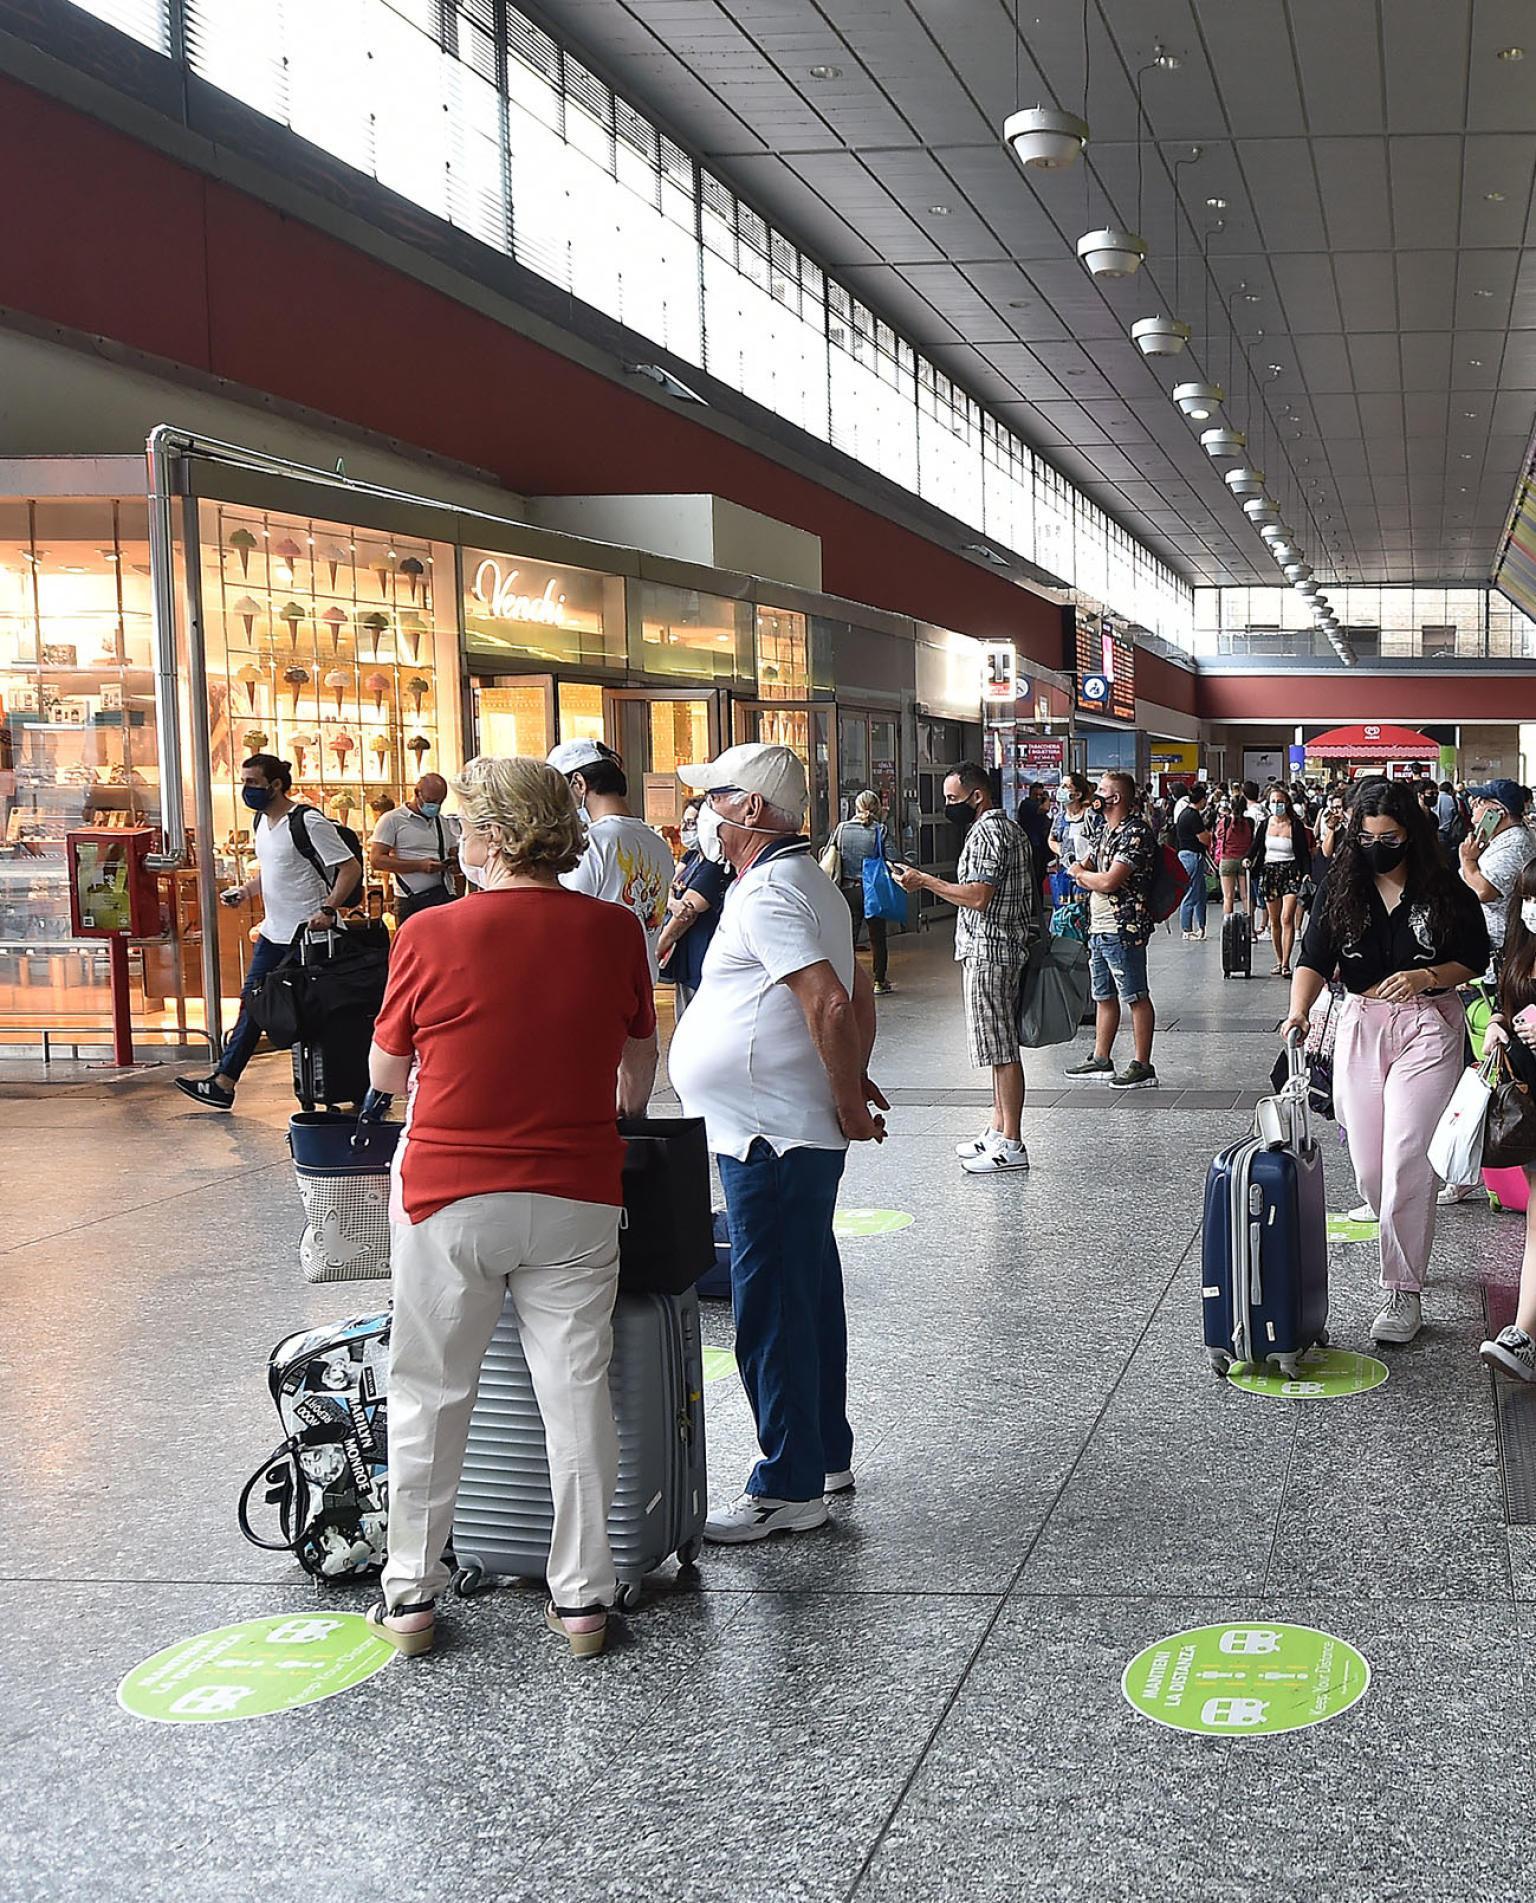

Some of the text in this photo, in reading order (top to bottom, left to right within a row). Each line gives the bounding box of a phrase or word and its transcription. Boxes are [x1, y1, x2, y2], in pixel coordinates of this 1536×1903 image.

[471, 559, 567, 626] Venchi
[197, 1082, 210, 1095] N
[305, 1398, 334, 1425] REPORT
[348, 1396, 374, 1448] MARILYN
[343, 1437, 371, 1493] MONROE
[1164, 1644, 1197, 1707] LA DISTANZA
